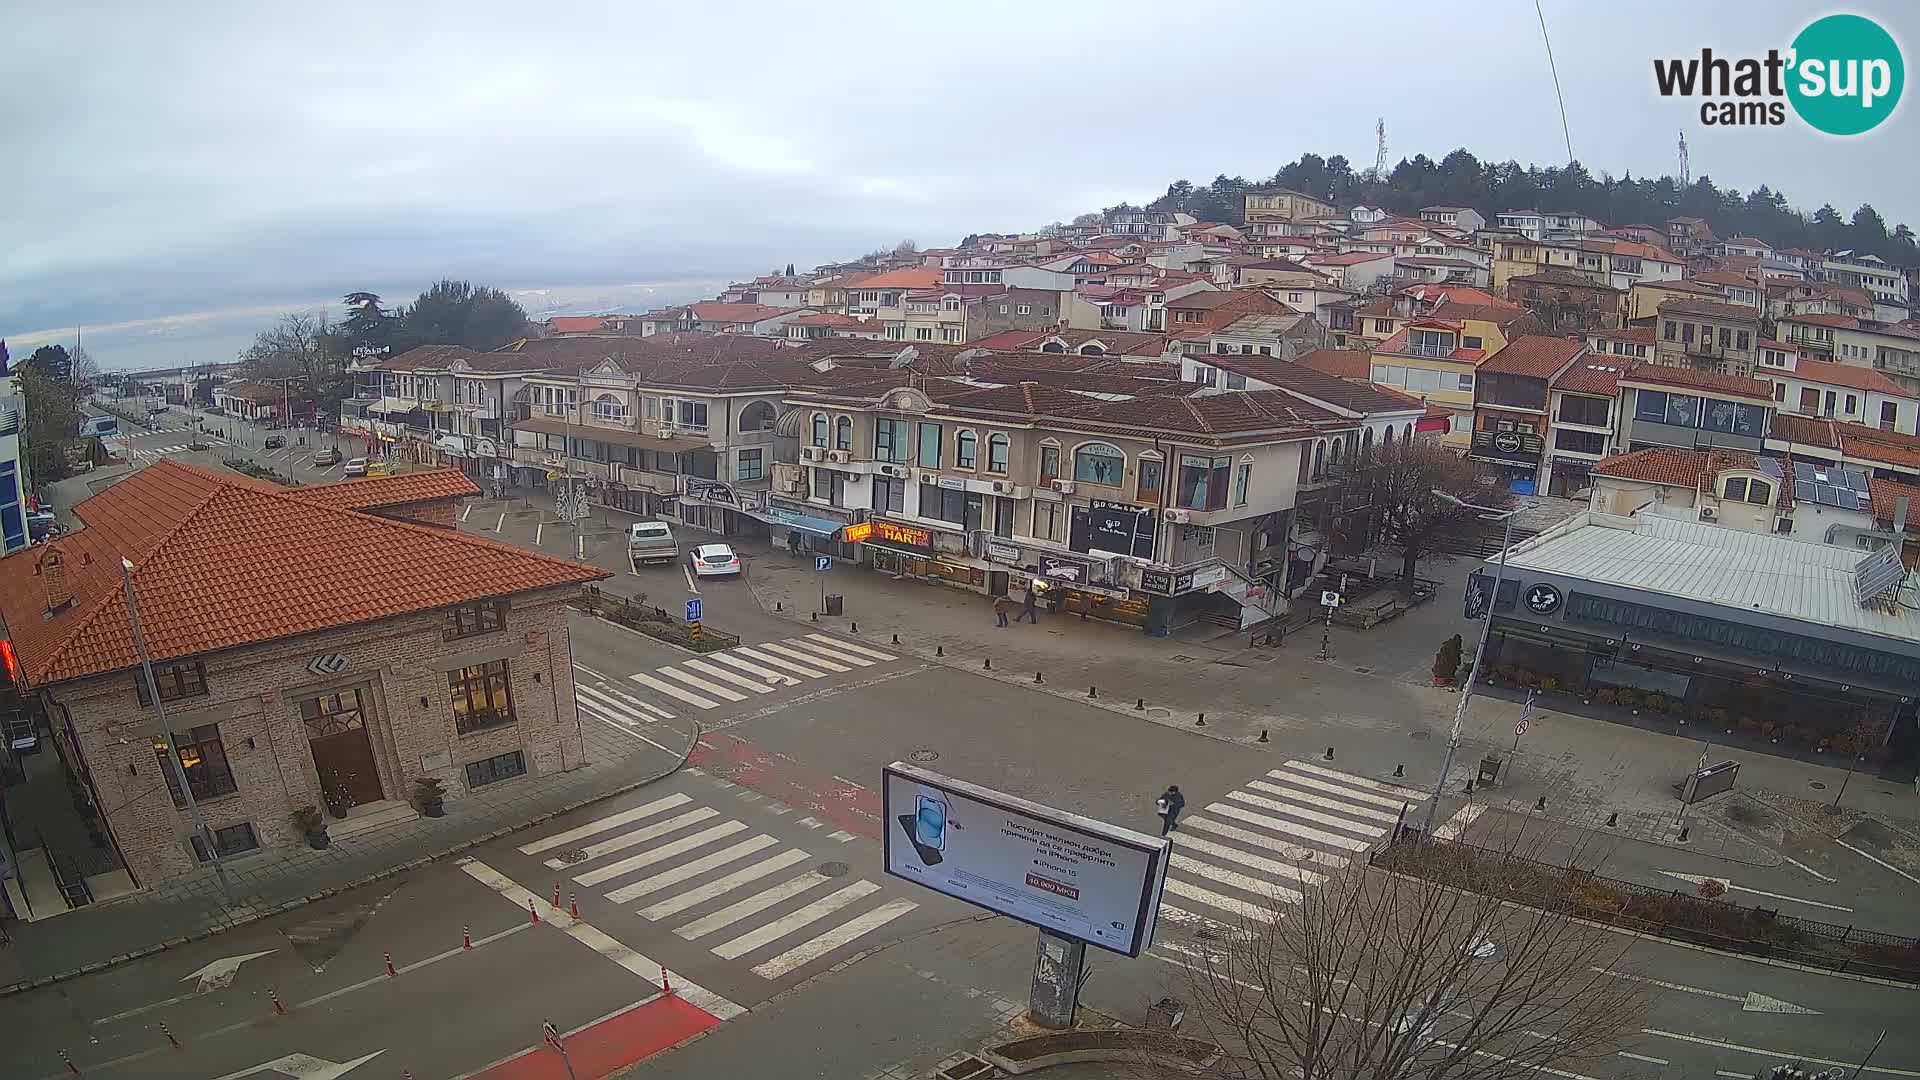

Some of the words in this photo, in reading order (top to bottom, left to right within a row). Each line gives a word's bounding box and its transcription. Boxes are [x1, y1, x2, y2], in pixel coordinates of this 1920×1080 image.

[884, 529, 916, 545] HARI
[820, 558, 828, 570] P
[1001, 828, 1038, 844] причини
[1039, 840, 1051, 849] да
[1064, 848, 1116, 867] префрлите
[1006, 820, 1045, 837] Постојат
[1045, 834, 1081, 849] милион
[1082, 844, 1112, 858] добри
[1036, 847, 1047, 855] на
[1048, 849, 1079, 865] iPhone
[1039, 860, 1067, 874] iPhone
[1068, 869, 1077, 877] 15
